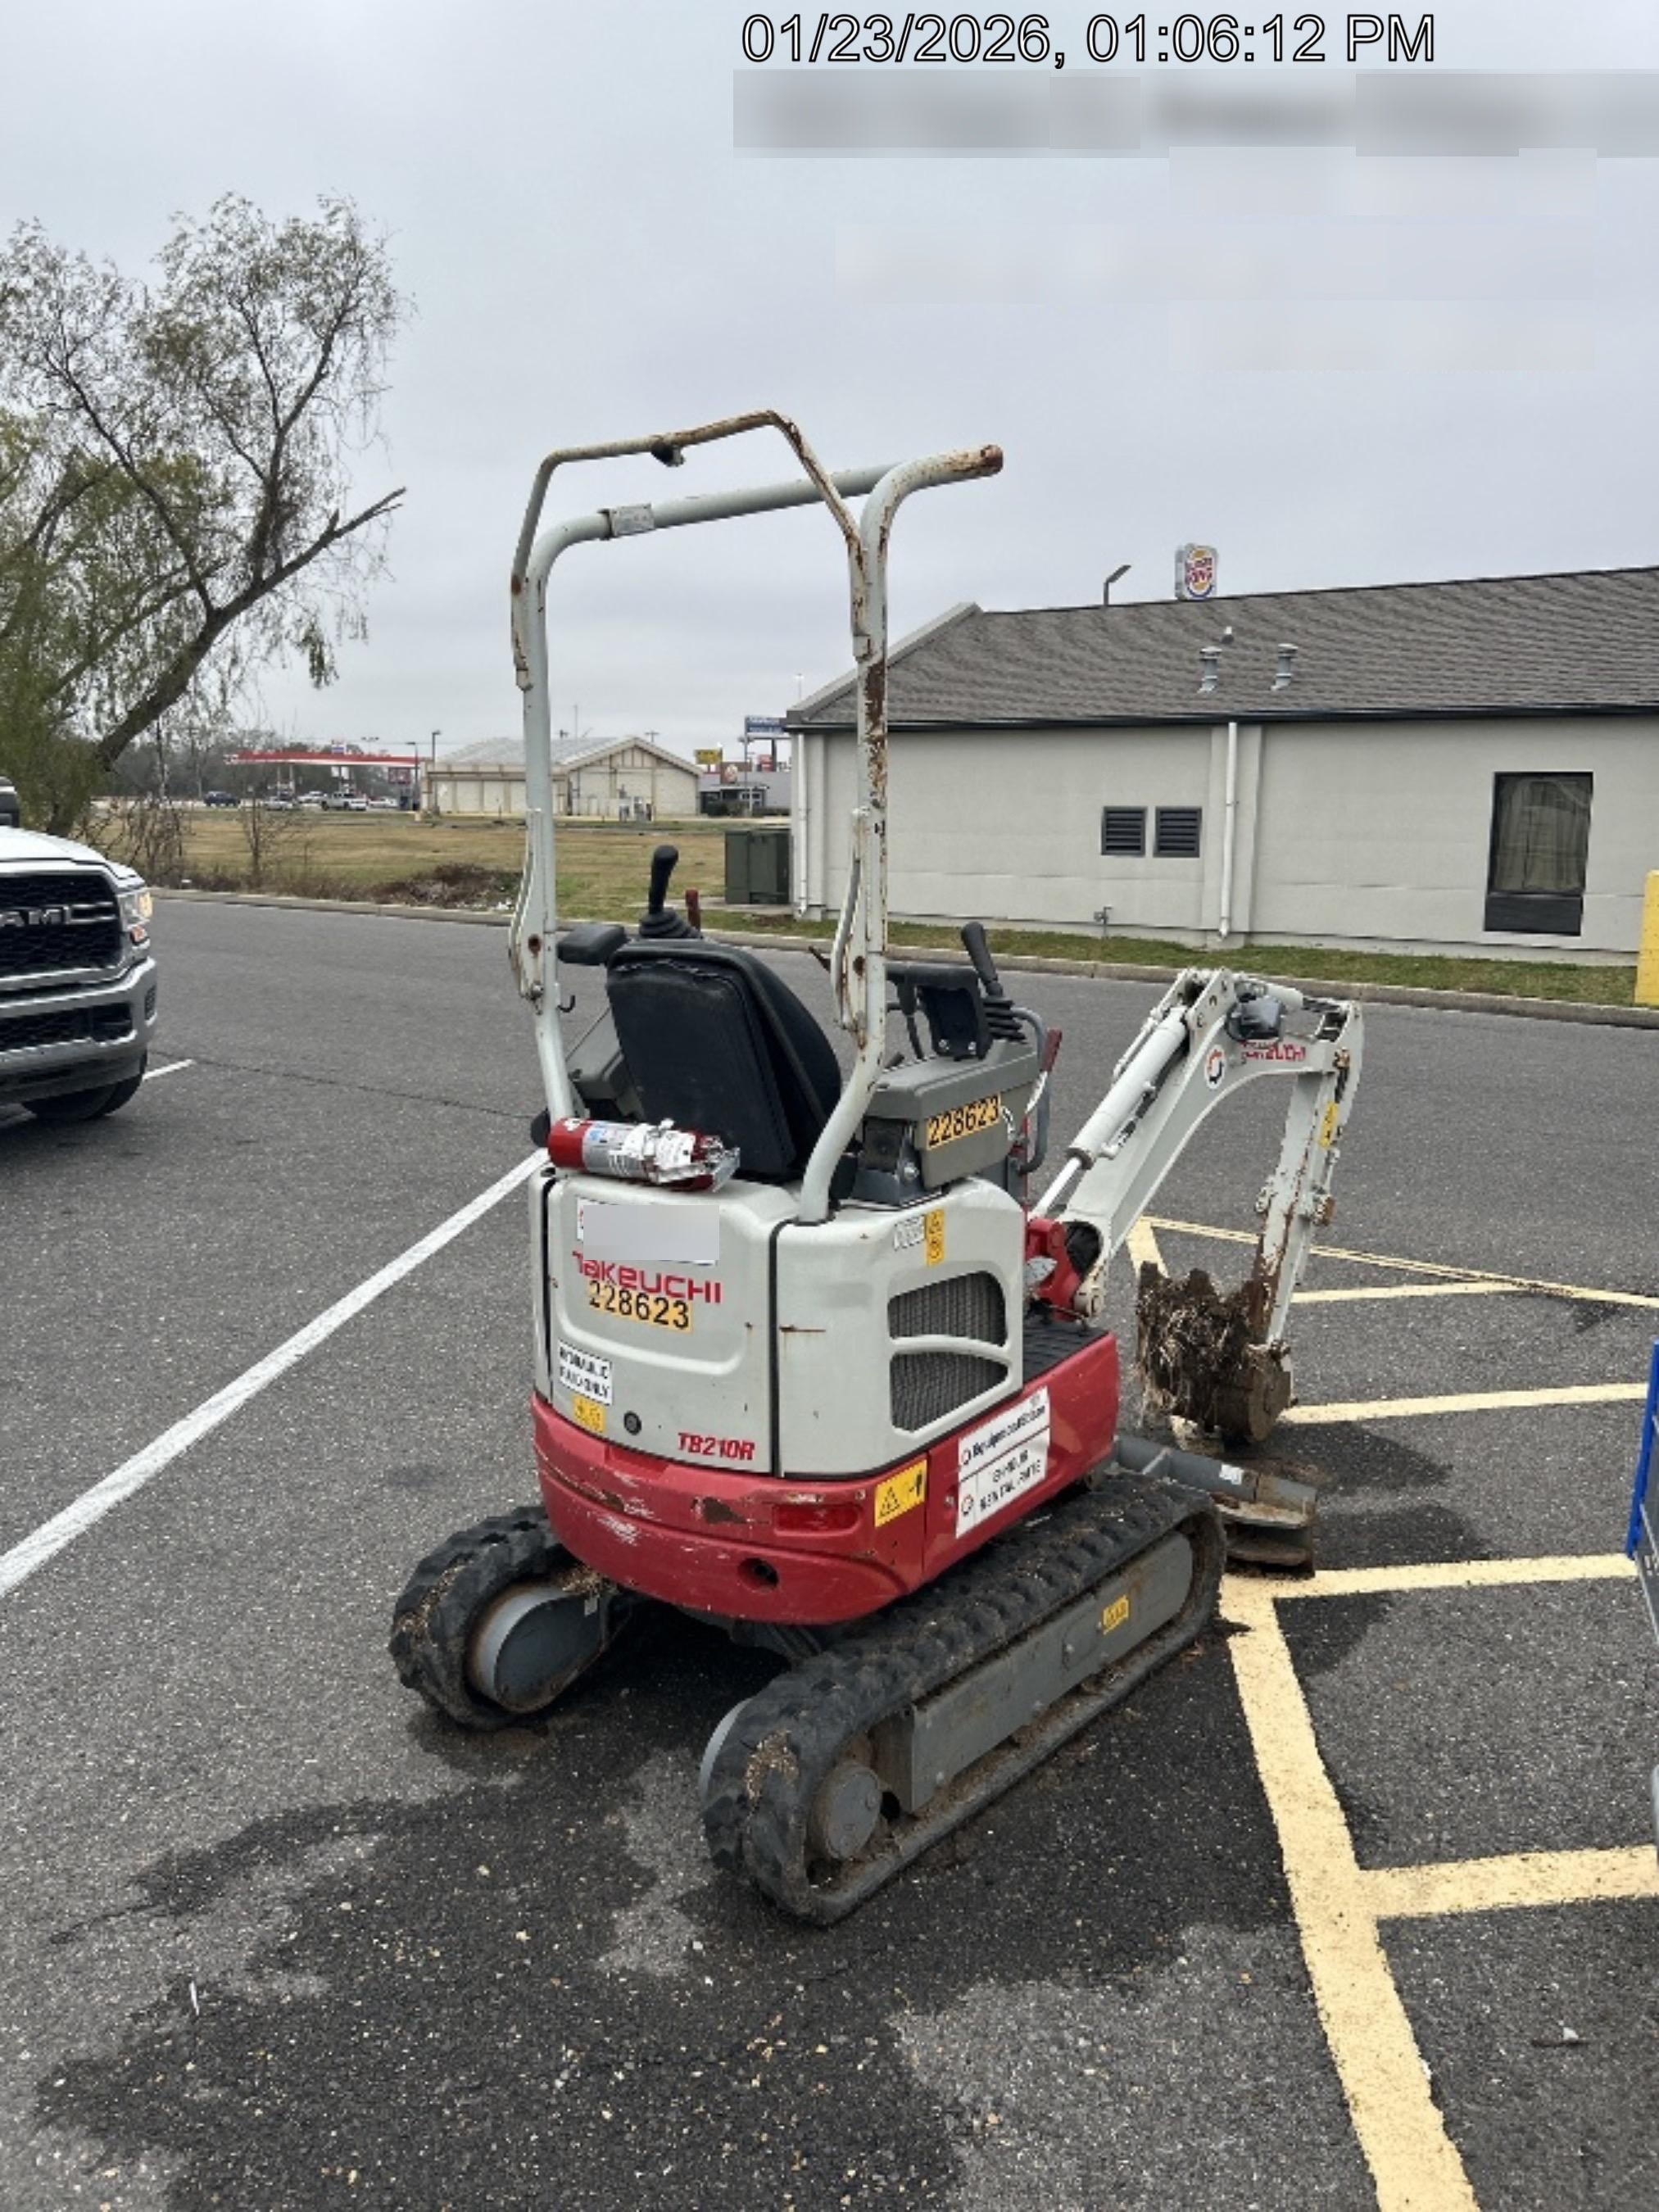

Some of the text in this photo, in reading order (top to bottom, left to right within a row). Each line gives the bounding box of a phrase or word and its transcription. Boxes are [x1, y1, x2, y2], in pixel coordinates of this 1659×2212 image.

[0, 909, 61, 927] AM
[928, 1095, 1000, 1146] 228623
[589, 1280, 690, 1330] 228623
[678, 1432, 755, 1461] TB210R
